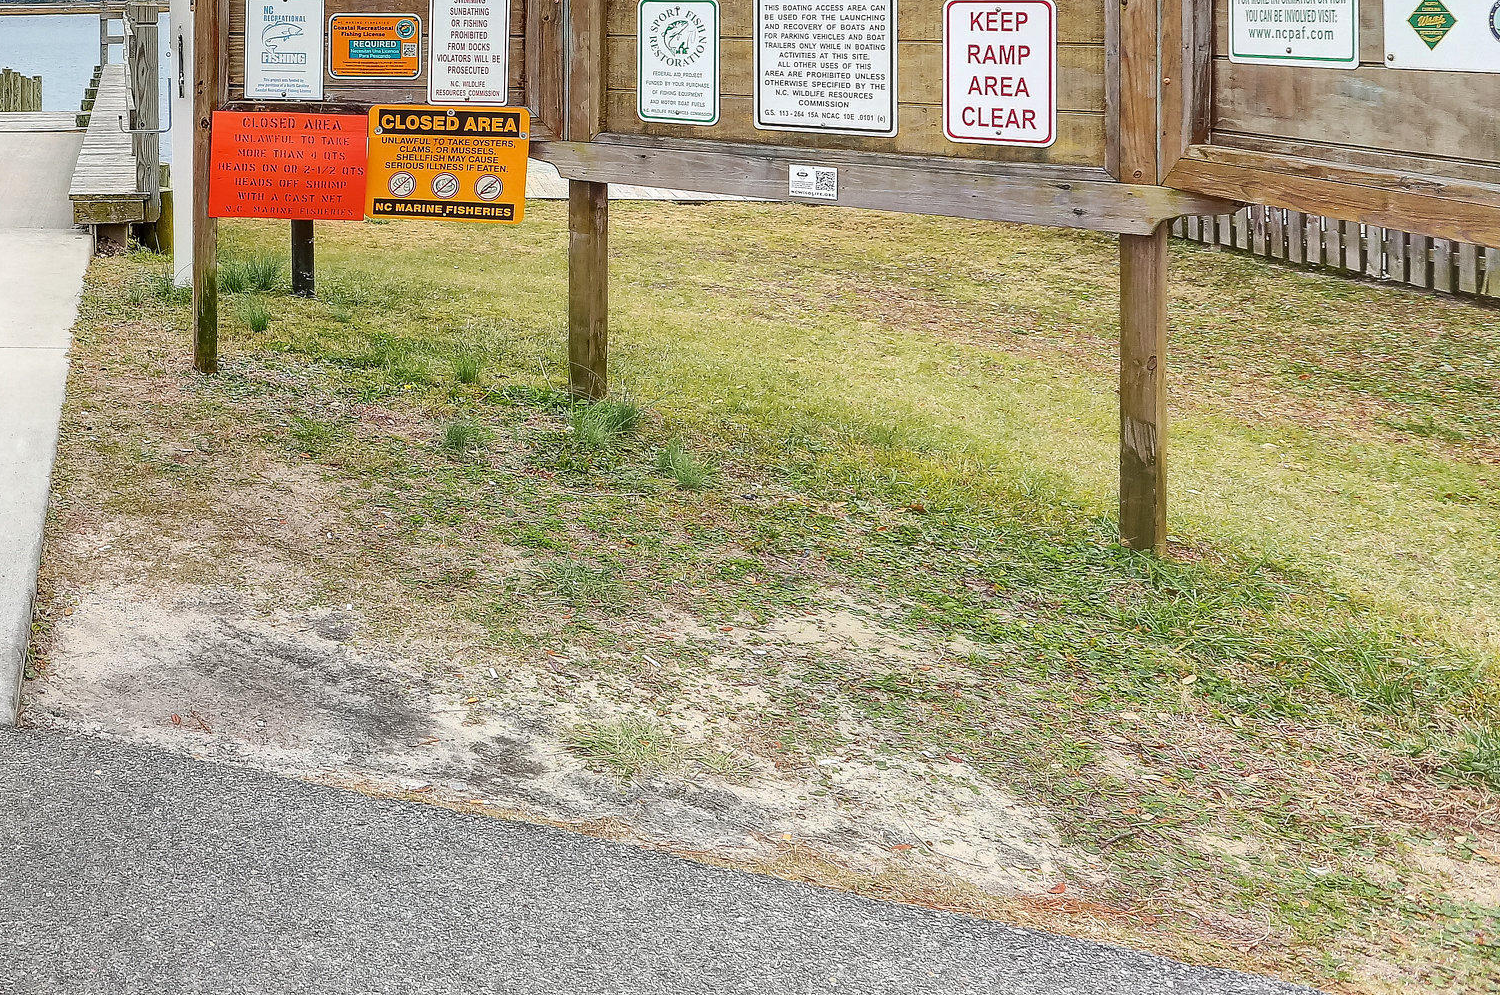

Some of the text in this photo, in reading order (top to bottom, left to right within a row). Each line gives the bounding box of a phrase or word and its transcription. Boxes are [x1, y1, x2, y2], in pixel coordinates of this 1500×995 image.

[264, 6, 274, 14] NC
[651, 6, 706, 33] SPORT FISH
[970, 12, 1028, 32] KEEP
[1246, 10, 1258, 22] YOU
[1260, 10, 1271, 22] CAN
[1272, 10, 1283, 22] BE
[1284, 10, 1315, 23] INVOLVED
[451, 31, 487, 39] PROHIBITED
[1249, 26, 1334, 42] www.ncpaf.com
[469, 43, 490, 51] DOCKS
[649, 35, 707, 67] RESTORATION
[262, 53, 306, 64] FISHING
[437, 54, 471, 62] VIOLATORS
[474, 55, 488, 63] WILL
[968, 45, 1030, 65] RAMP
[447, 66, 489, 74] PROSECUTED
[968, 76, 1030, 97] AREA
[242, 116, 341, 130] CLOSED AREA
[381, 115, 517, 132] CLOSED AREA
[962, 106, 1036, 130] CLEAR
[235, 134, 350, 145] UNLAWFUL TO TAKE
[381, 137, 428, 145] UNLAWFUL
[473, 140, 516, 148] OYSTERS,
[237, 149, 266, 157] MORE
[274, 150, 304, 159] THAN
[324, 152, 346, 160] QTS
[396, 154, 445, 162] SHELLFISH
[468, 156, 498, 164] CAUSE
[219, 163, 256, 171] HEADS
[262, 164, 277, 172] ON
[284, 165, 297, 173] OR
[342, 167, 365, 175] QTS
[385, 162, 424, 170] SERIOUS
[477, 165, 509, 173] EATEN.
[234, 178, 272, 187] HEADS
[306, 181, 347, 189] SHRIMP
[238, 192, 264, 201] WITH
[285, 194, 315, 202] CAST
[321, 195, 342, 203] NET
[375, 203, 511, 217] NC MARINE FISHERIES
